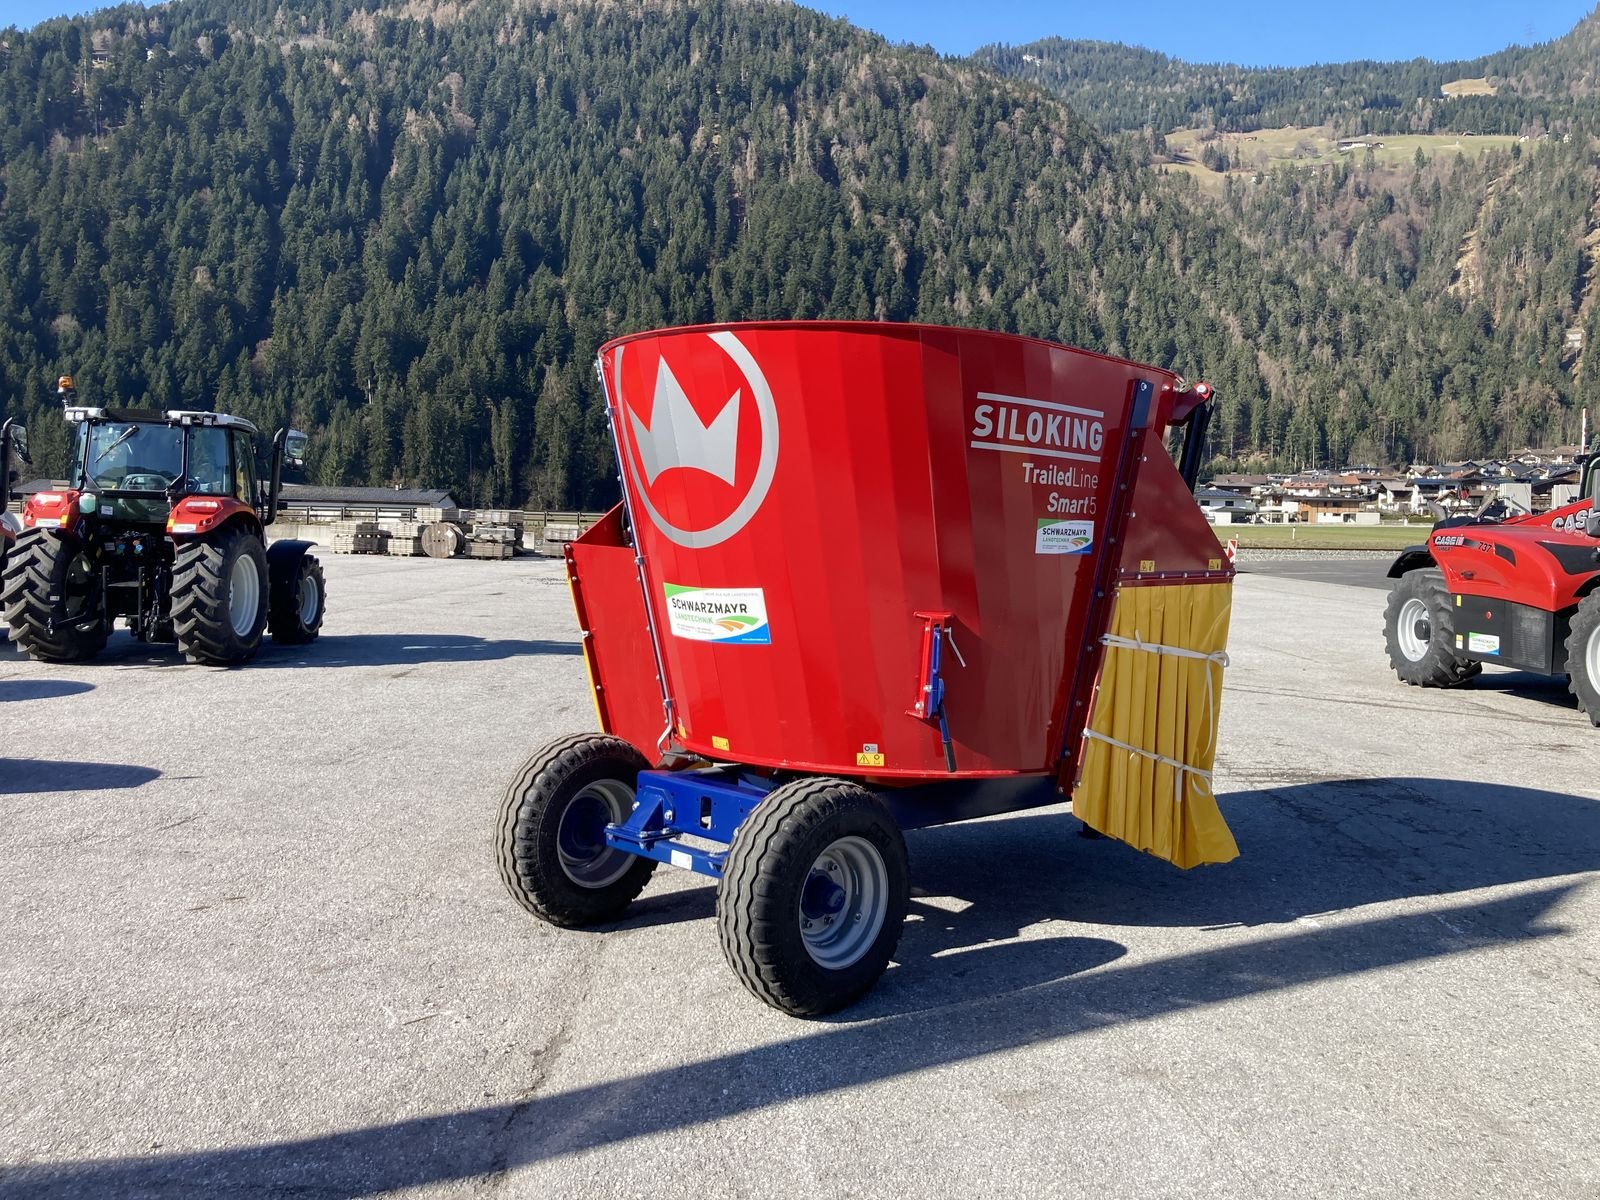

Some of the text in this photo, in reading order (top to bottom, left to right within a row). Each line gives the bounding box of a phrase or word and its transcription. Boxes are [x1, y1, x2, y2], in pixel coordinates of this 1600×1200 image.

[972, 404, 1103, 451] SILOKING
[1022, 462, 1098, 489] TrailedLine
[1042, 528, 1087, 536] SCHWARZMAYR
[1478, 541, 1493, 552] 737
[671, 598, 748, 614] SCHWARZMAYR
[675, 612, 713, 624] LANDTECHNIK
